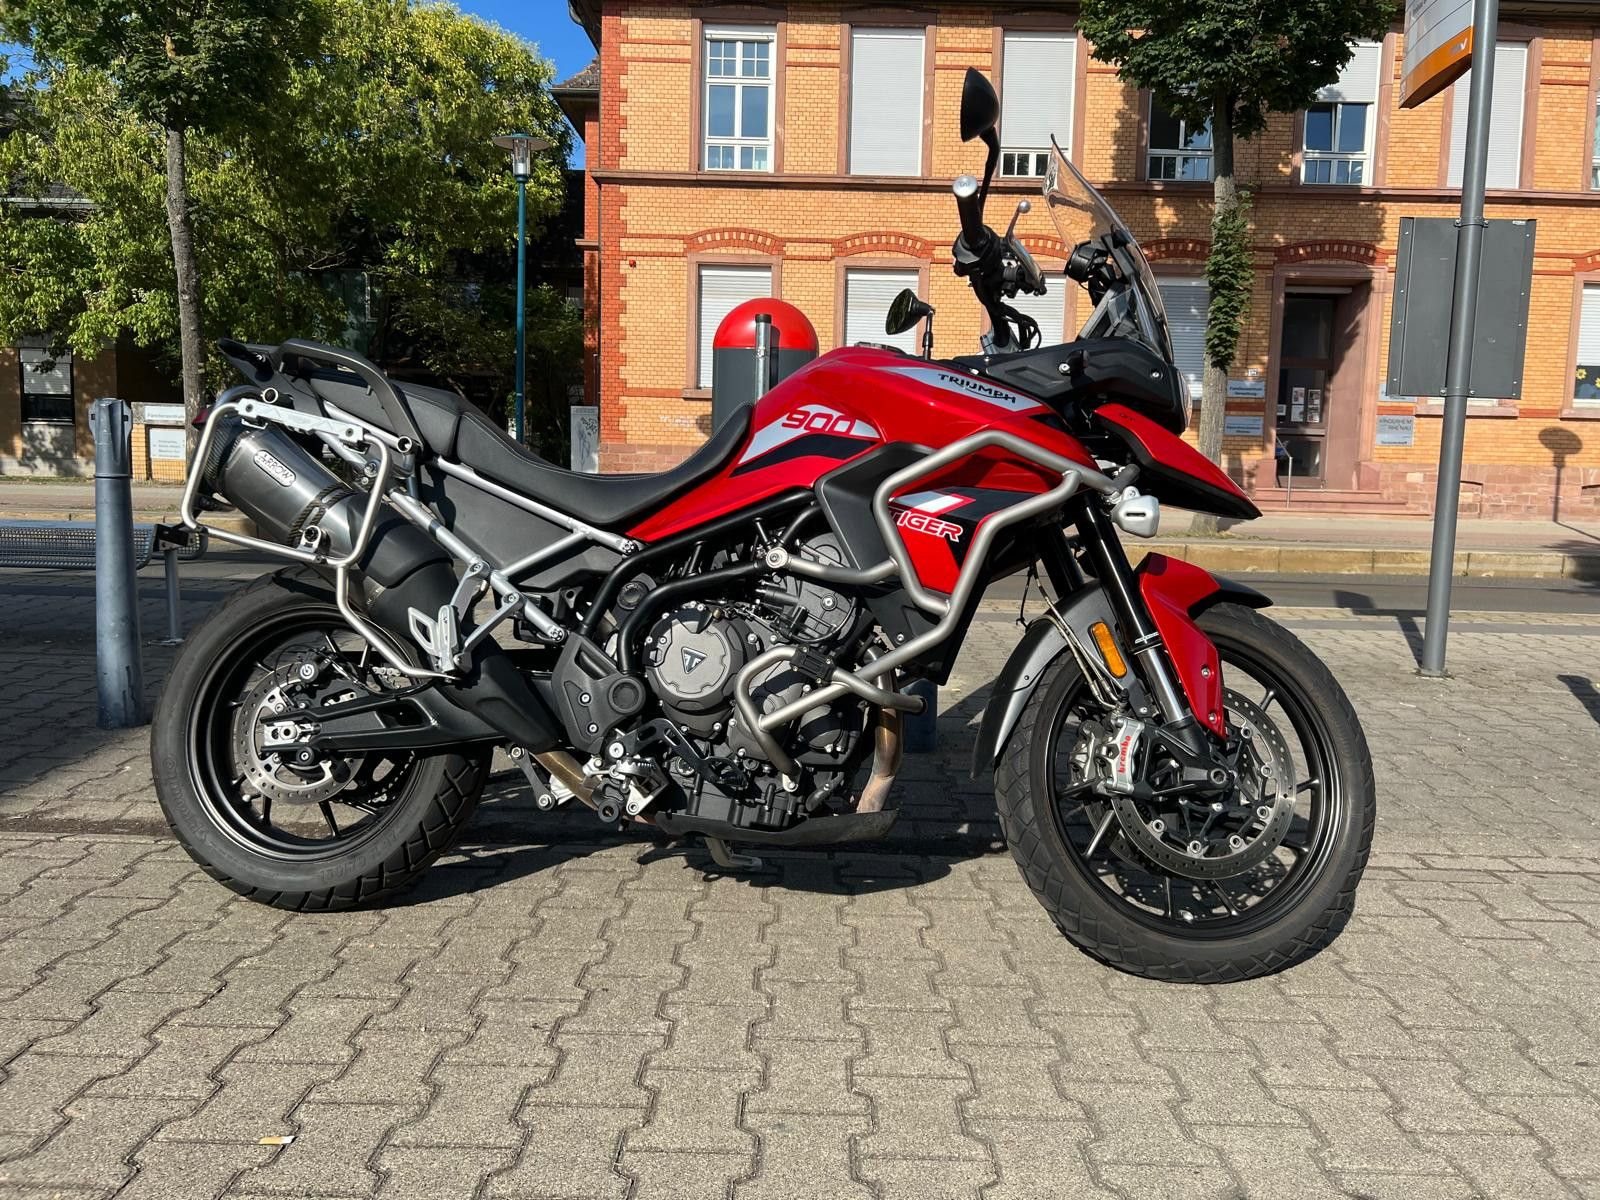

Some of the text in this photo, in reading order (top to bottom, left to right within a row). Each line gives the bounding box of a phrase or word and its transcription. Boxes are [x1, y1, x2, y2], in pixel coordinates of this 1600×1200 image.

[938, 373, 1016, 404] TRIUMPH
[781, 409, 856, 434] 900
[258, 453, 293, 479] ARROW
[1117, 735, 1132, 773] brembo
